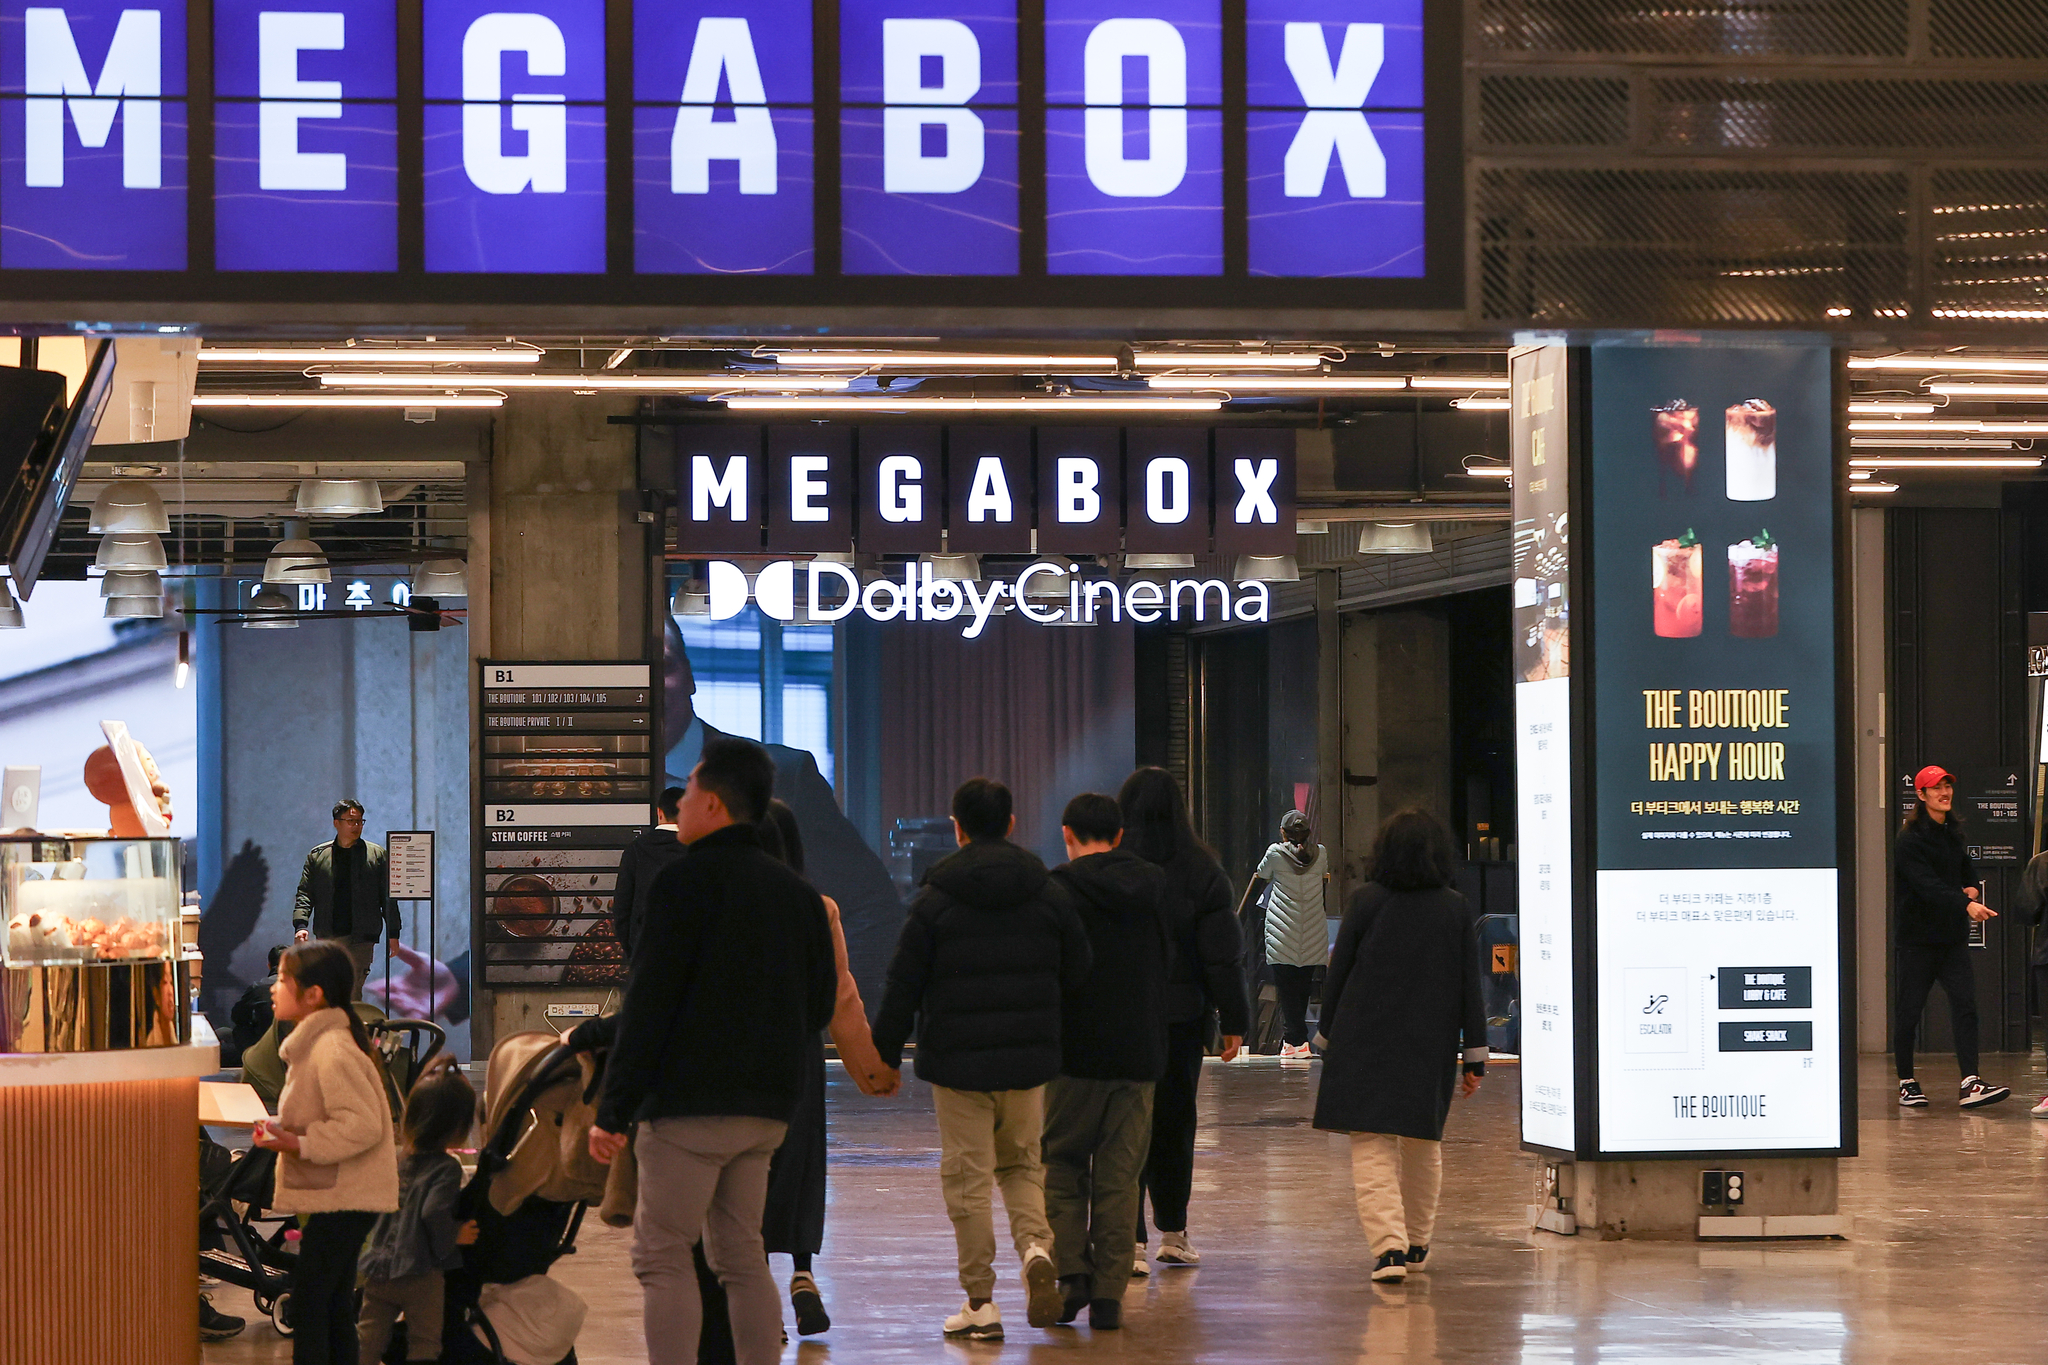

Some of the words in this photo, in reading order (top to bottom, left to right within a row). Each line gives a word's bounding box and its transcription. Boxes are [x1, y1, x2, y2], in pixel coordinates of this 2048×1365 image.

[24, 8, 1387, 198] MEGABOX
[690, 455, 1279, 525] MEGABOX
[808, 560, 1004, 639] Dolby
[1014, 561, 1270, 623] Cinema
[495, 670, 514, 683] B1
[488, 693, 499, 704] THE
[500, 693, 526, 704] BOUTIQUE
[532, 693, 542, 704] 101
[548, 693, 558, 704] 102
[564, 693, 574, 704] 103
[580, 693, 590, 704] 104
[596, 693, 607, 704] 105
[1642, 689, 1682, 729] THE
[1688, 689, 1790, 732] BOUTIQUE
[488, 716, 499, 727] THE
[500, 716, 526, 727] BOUTIQUE
[527, 716, 550, 727] PRIVATE
[1649, 742, 1722, 782] HAPPY
[1728, 742, 1785, 782] HOUR
[1630, 800, 1643, 815] 더
[1645, 800, 1702, 815] 부티크에서
[1703, 800, 1738, 815] 보내는
[1739, 800, 1775, 815] 행복한
[1776, 800, 1800, 815] 시간
[496, 809, 515, 822] B2
[491, 831, 516, 842] STEM
[517, 831, 548, 842] COFFEE
[1659, 893, 1669, 905] 더
[1672, 893, 1701, 905] 부티크
[1704, 893, 1733, 905] 카페는
[1736, 893, 1772, 905] 지하1층
[1636, 910, 1646, 922] 더
[1650, 910, 1679, 922] 부티크
[1681, 910, 1711, 922] 매표소
[1756, 910, 1799, 922] 있습니다.
[1673, 1096, 1697, 1118] THE
[1702, 1095, 1766, 1119] BOUTIQUE
